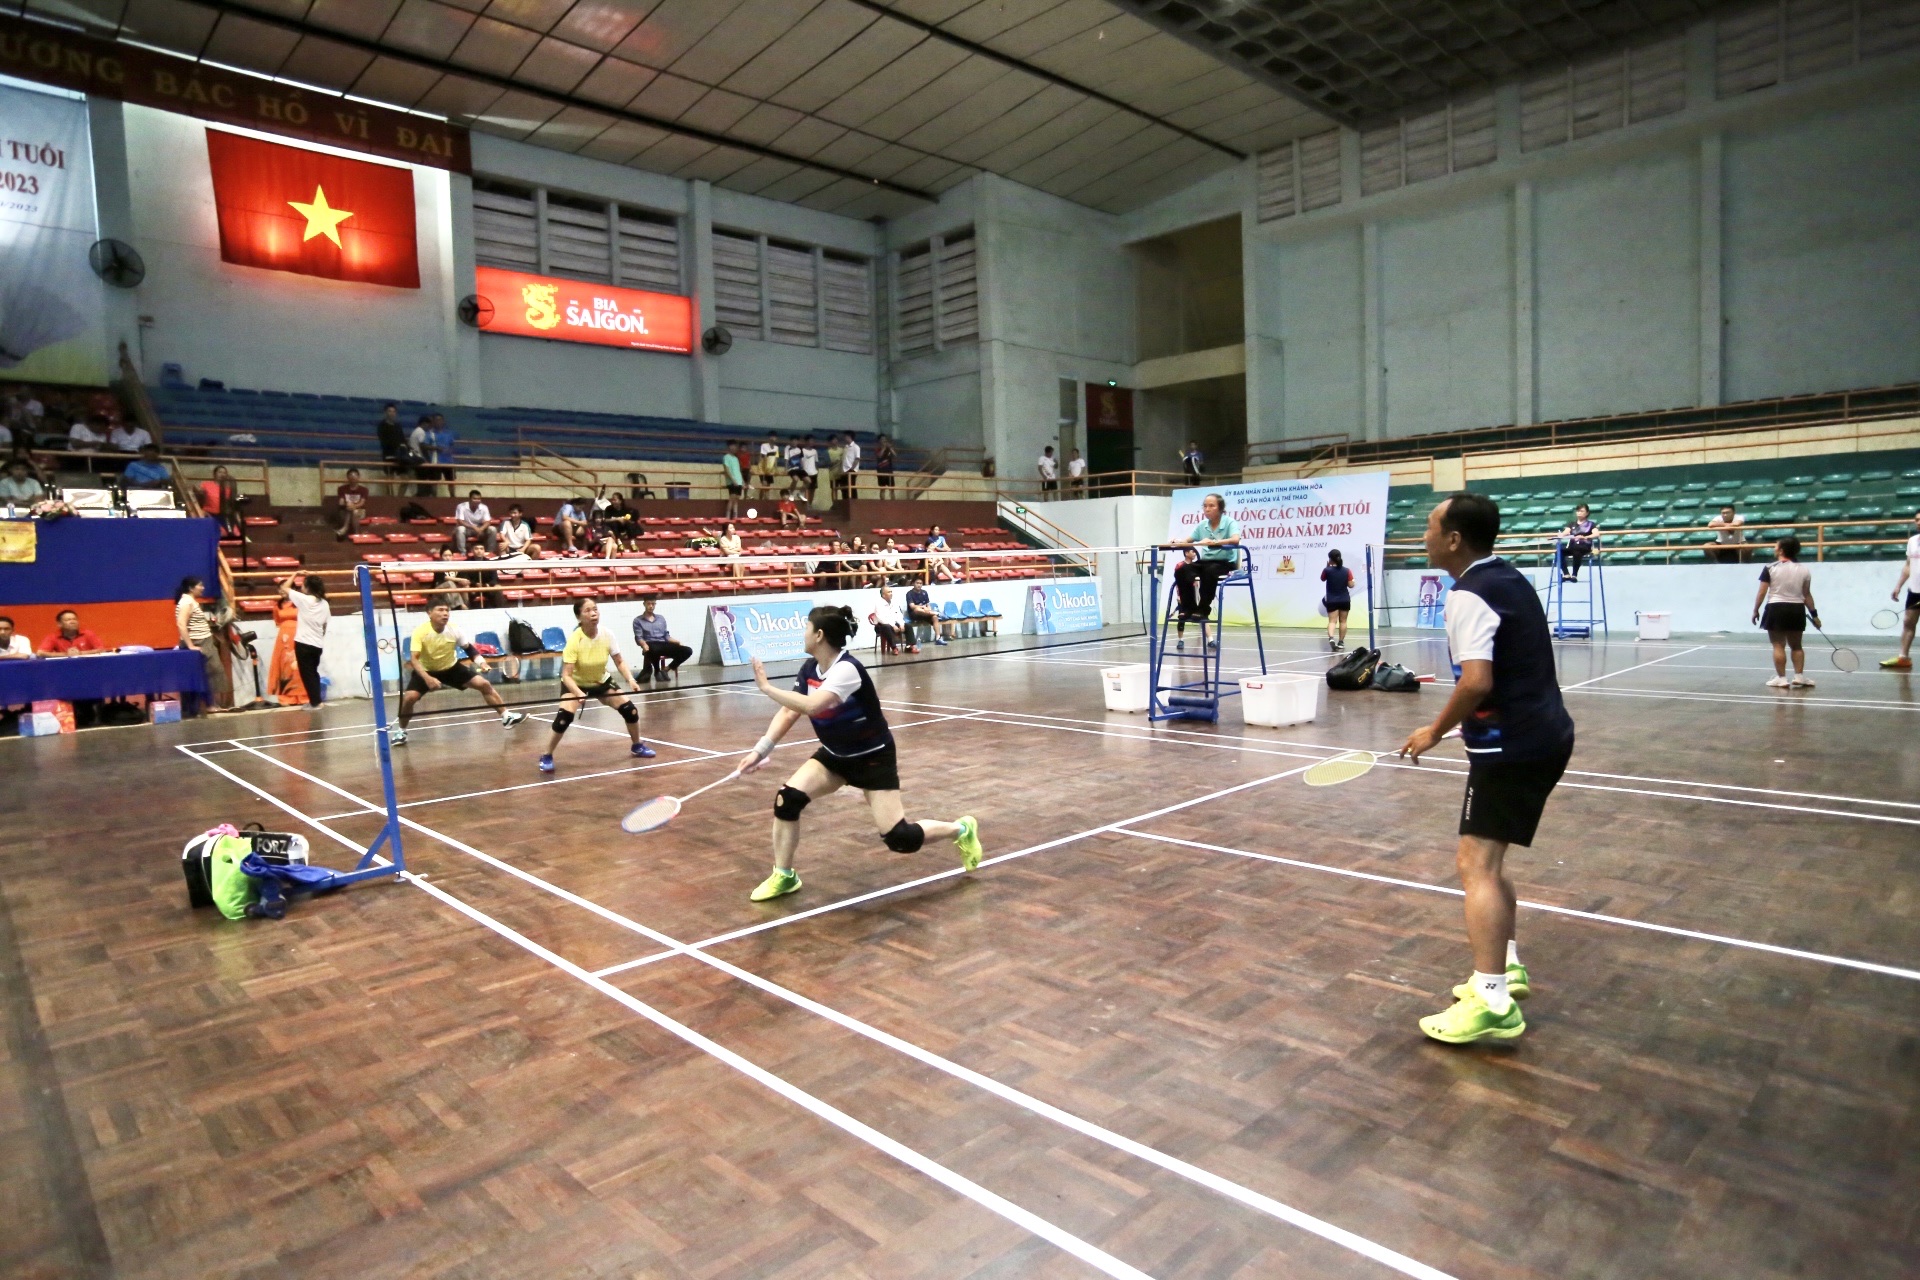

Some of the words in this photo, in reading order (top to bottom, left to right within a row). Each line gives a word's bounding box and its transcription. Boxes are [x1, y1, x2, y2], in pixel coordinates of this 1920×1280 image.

[593, 297, 618, 312] BIA
[1233, 487, 1244, 496] BAN
[1234, 506, 1266, 522] LÔNG
[1269, 505, 1295, 520] CÁC
[1296, 502, 1335, 519] NHÓM
[1266, 523, 1293, 539] HÒA
[1295, 522, 1324, 538] NĂM
[1327, 523, 1352, 536] 2023
[1052, 587, 1096, 609] Vikoda
[256, 837, 288, 854] FORZ
